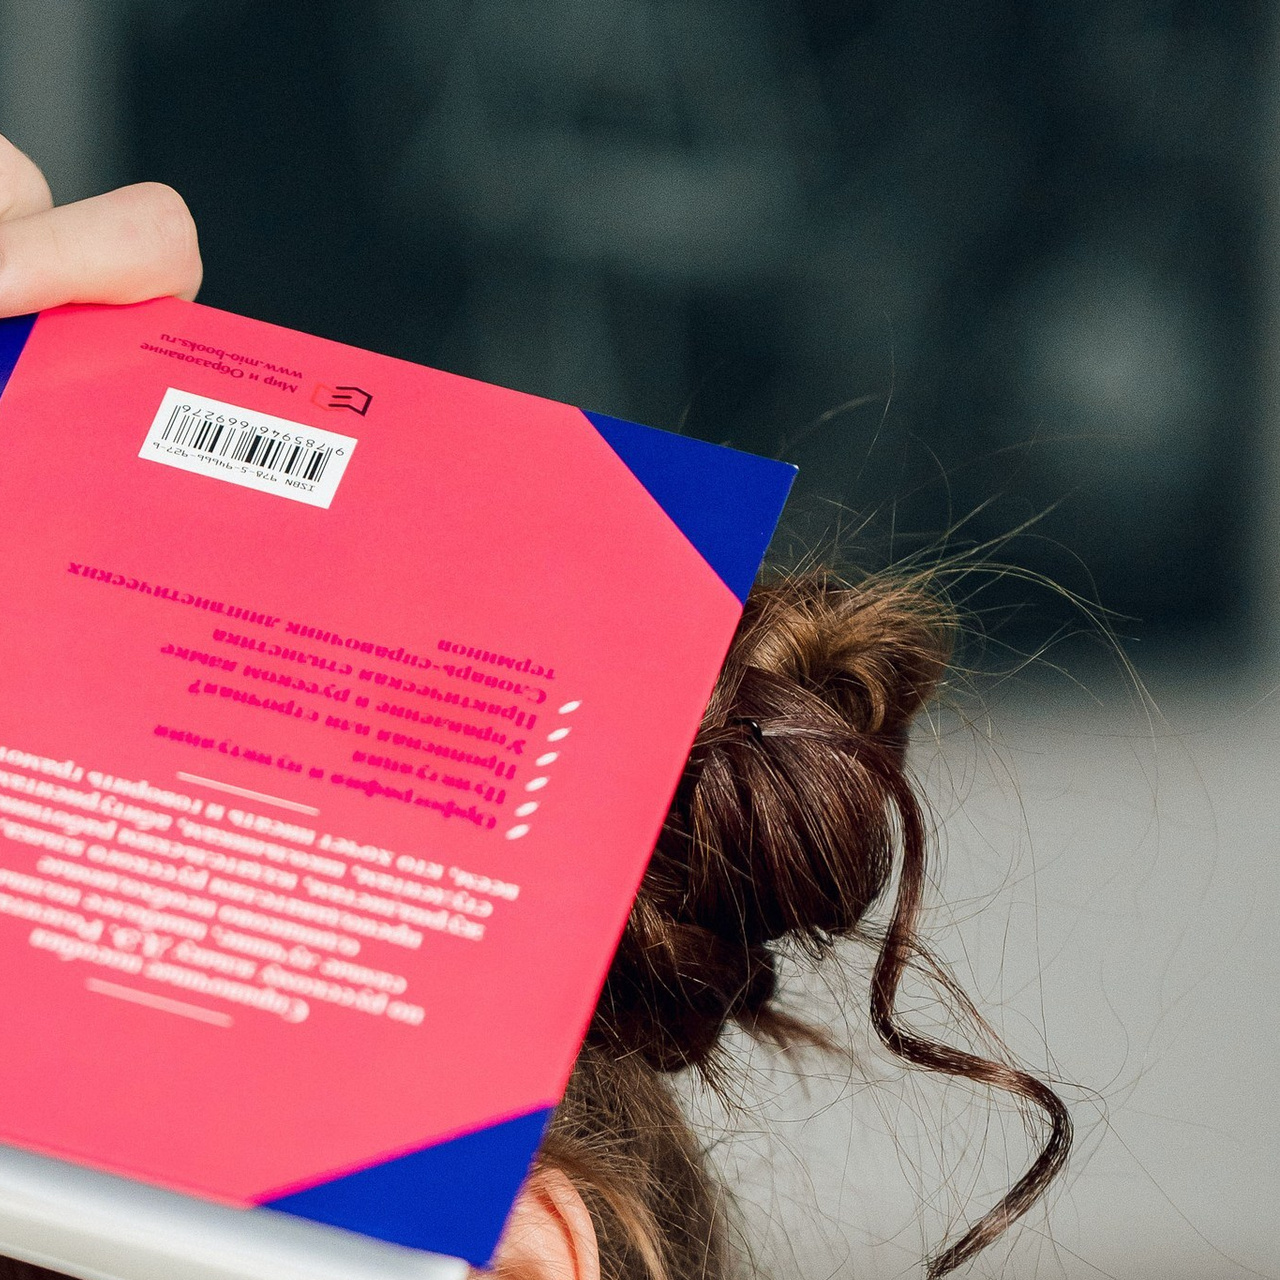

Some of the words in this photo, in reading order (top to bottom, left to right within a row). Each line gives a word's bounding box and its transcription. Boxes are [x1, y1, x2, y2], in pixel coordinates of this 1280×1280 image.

[139, 342, 245, 379] Образование
[160, 333, 303, 379] www.mio-books.ru
[248, 372, 260, 381] и
[263, 375, 299, 394] Мир
[152, 441, 278, 482] 978-5-94666-927-6
[284, 478, 314, 492] ISBN
[65, 560, 283, 630] лингвистических
[158, 642, 240, 674] языке
[210, 626, 355, 677] стилистика
[283, 619, 549, 707] Словарь-справочник
[435, 637, 556, 682] терминов
[185, 677, 321, 724] строчная?
[240, 663, 353, 705] русском
[356, 667, 539, 732] Практическая
[323, 713, 373, 738] или
[373, 700, 528, 757] Управление
[374, 727, 518, 782] Прописная
[85, 769, 205, 817] говорить
[203, 801, 227, 822] и
[175, 816, 348, 880] школьникам,
[226, 807, 318, 847] писать
[85, 843, 211, 892] русского
[115, 823, 300, 892] издательским
[316, 832, 396, 868] хочет
[394, 853, 446, 882] кто
[349, 863, 495, 919] студентам,
[447, 865, 522, 902] всем,
[258, 956, 392, 1016] русскому
[319, 957, 409, 997] самые
[384, 999, 427, 1027] по
